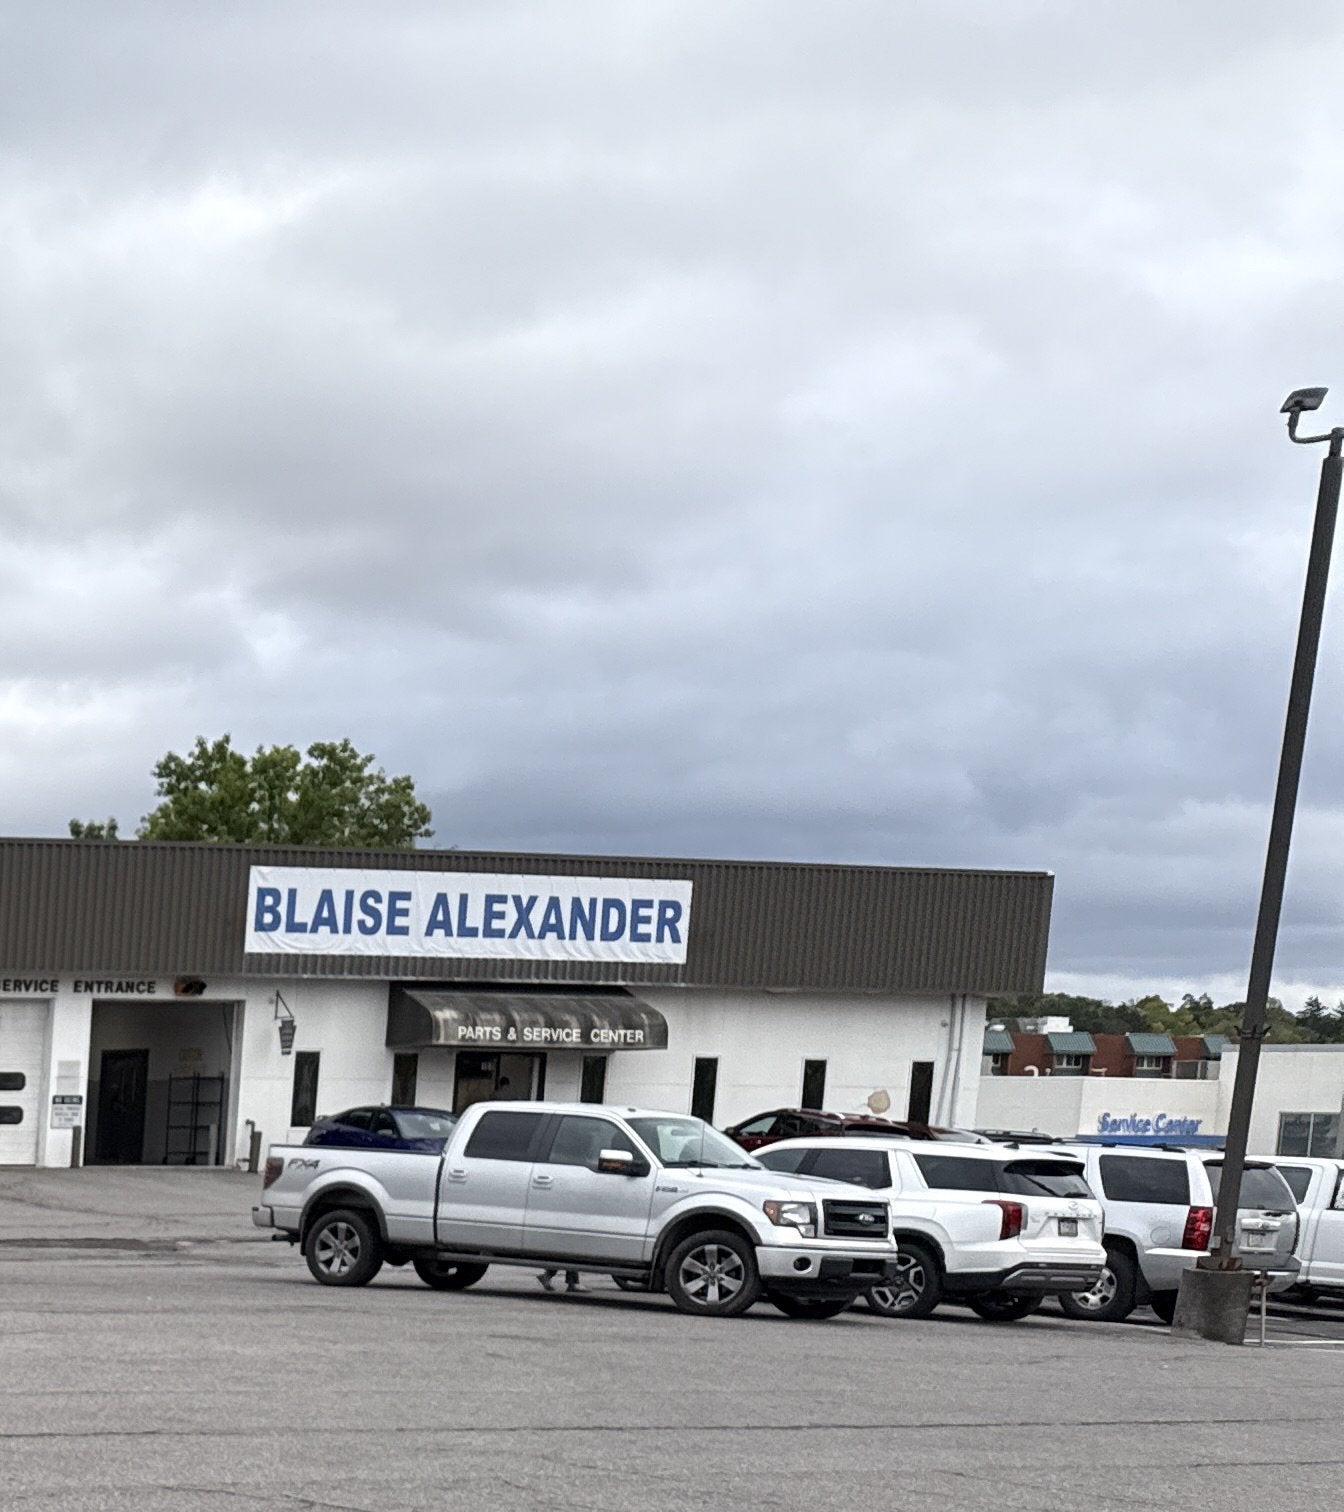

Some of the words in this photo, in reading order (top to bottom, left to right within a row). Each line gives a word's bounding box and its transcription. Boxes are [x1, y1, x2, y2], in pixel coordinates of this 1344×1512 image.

[254, 887, 412, 936] BLAISE
[424, 892, 683, 943] ALEXANDER
[73, 980, 156, 994] ENTRANCE
[457, 1026, 502, 1040] PARTS
[507, 1027, 517, 1041] &
[523, 1027, 582, 1042] SERVICE
[590, 1028, 645, 1043] CENTER
[1097, 1112, 1151, 1133] Service
[1152, 1113, 1203, 1134] Center
